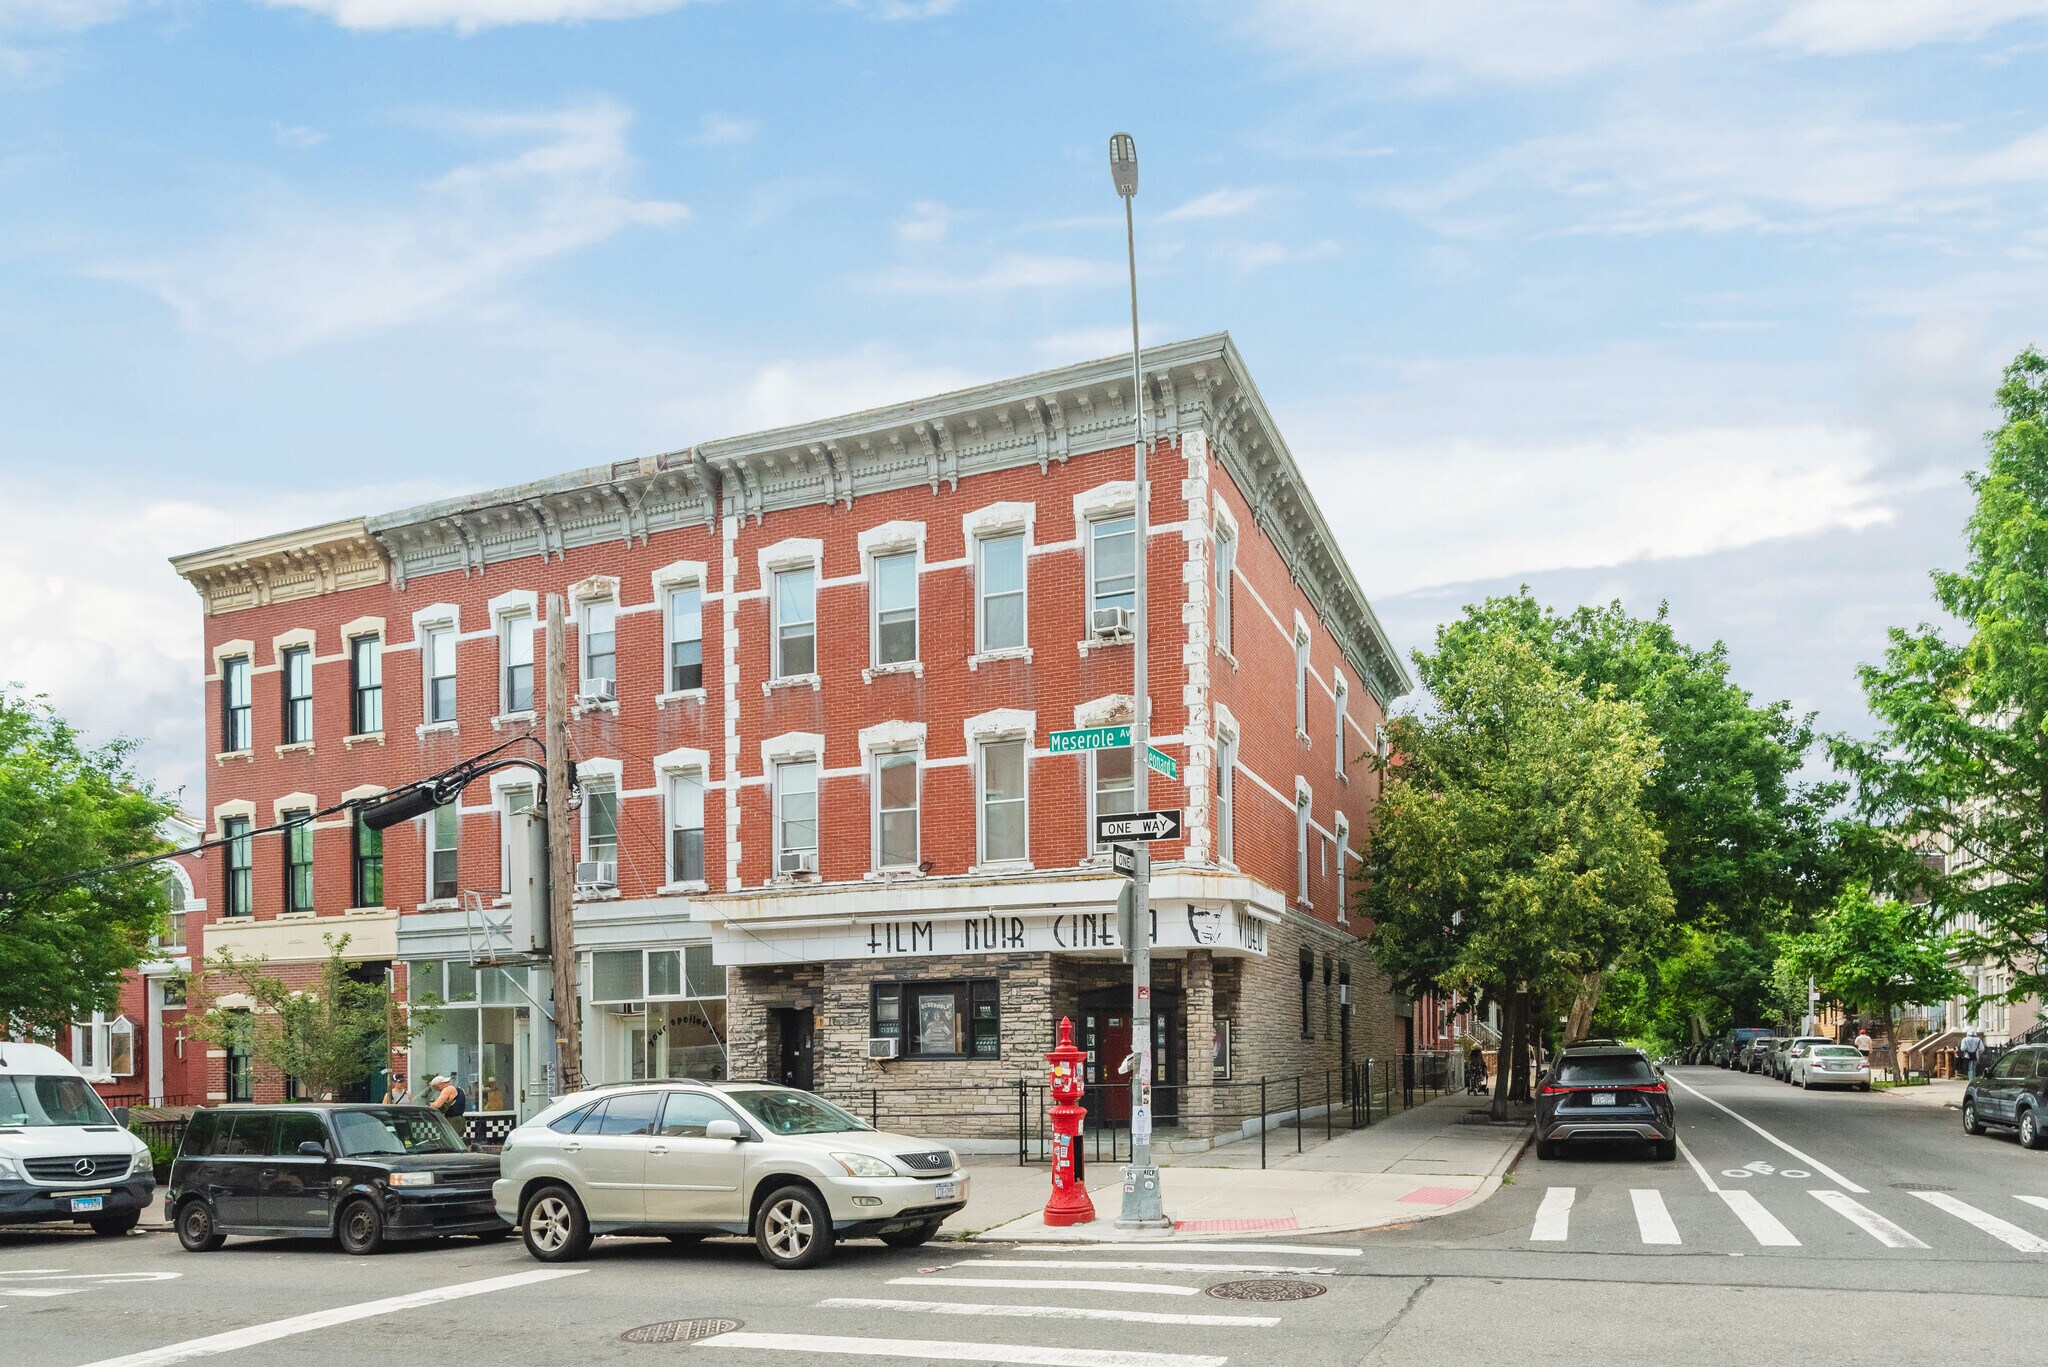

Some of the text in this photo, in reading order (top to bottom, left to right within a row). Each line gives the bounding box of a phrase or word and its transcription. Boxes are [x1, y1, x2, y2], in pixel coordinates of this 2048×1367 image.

[1051, 730, 1115, 751] Meserole
[1148, 752, 1171, 775] eonard
[1108, 820, 1168, 835] ONE WAY
[1118, 855, 1131, 869] ONE
[866, 920, 934, 954] FILM
[1053, 908, 1159, 949] CINEA
[1238, 911, 1264, 953] VIDEO
[648, 1025, 667, 1047] your
[670, 1014, 708, 1028] spoiled
